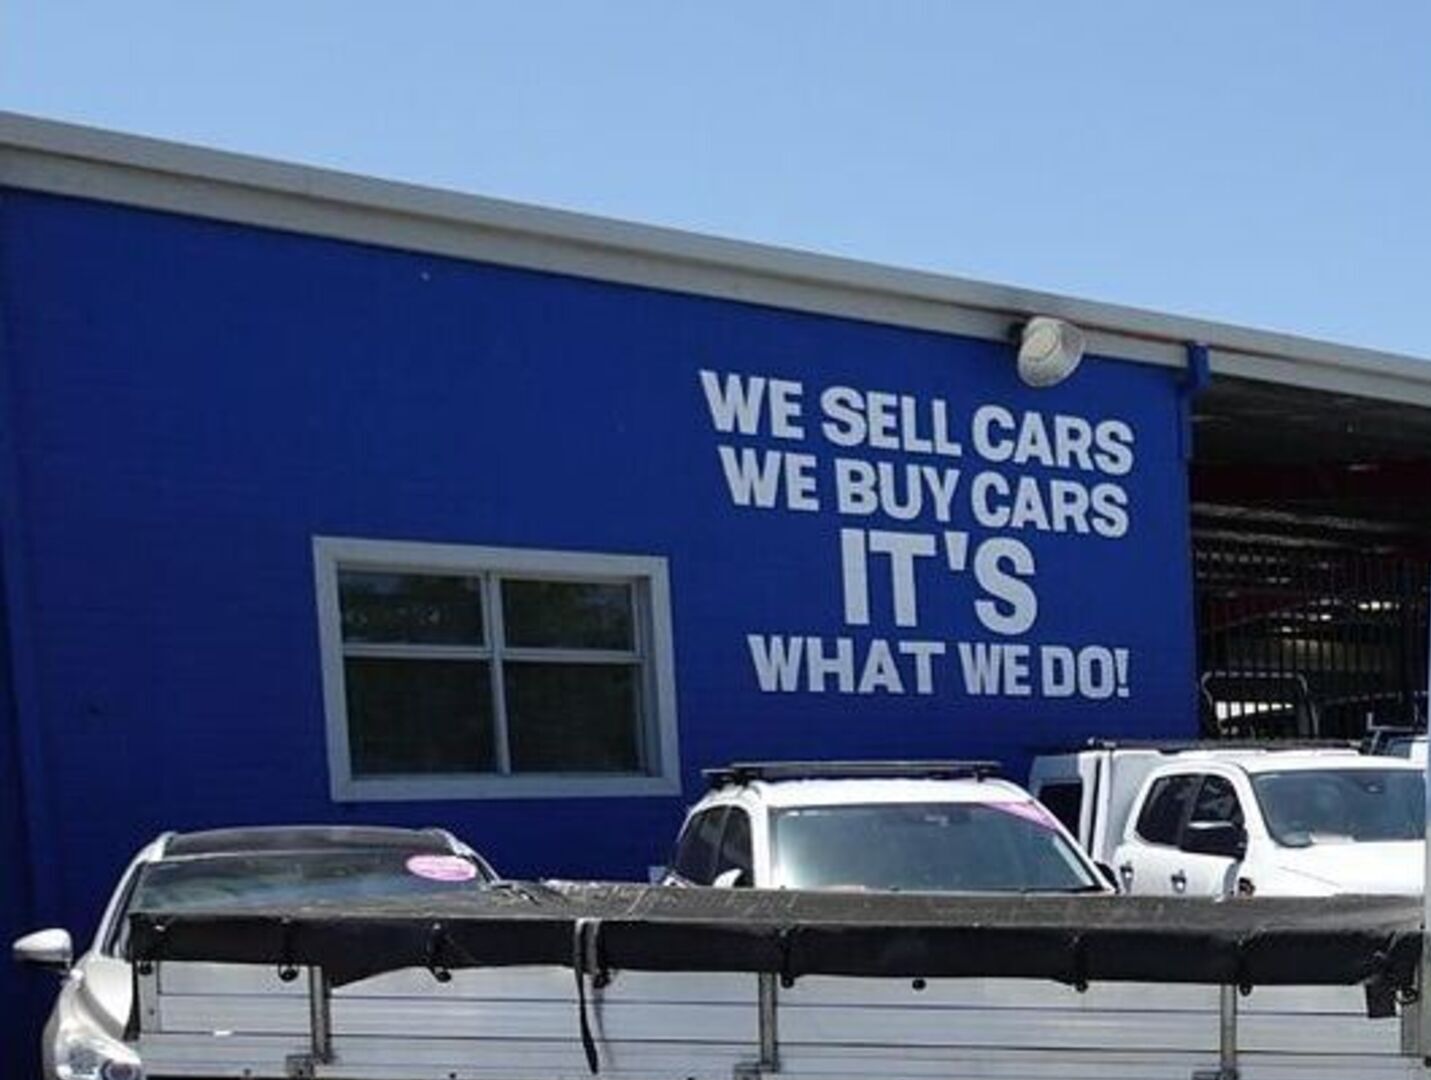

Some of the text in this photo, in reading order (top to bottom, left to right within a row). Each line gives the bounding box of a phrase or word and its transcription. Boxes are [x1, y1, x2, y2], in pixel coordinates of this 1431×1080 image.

[700, 370, 1133, 475] WE SELL CARS
[719, 446, 1129, 538] WE BUY CARS
[841, 528, 1038, 635] IT'S
[747, 634, 1130, 699] WHAT WE DO!
